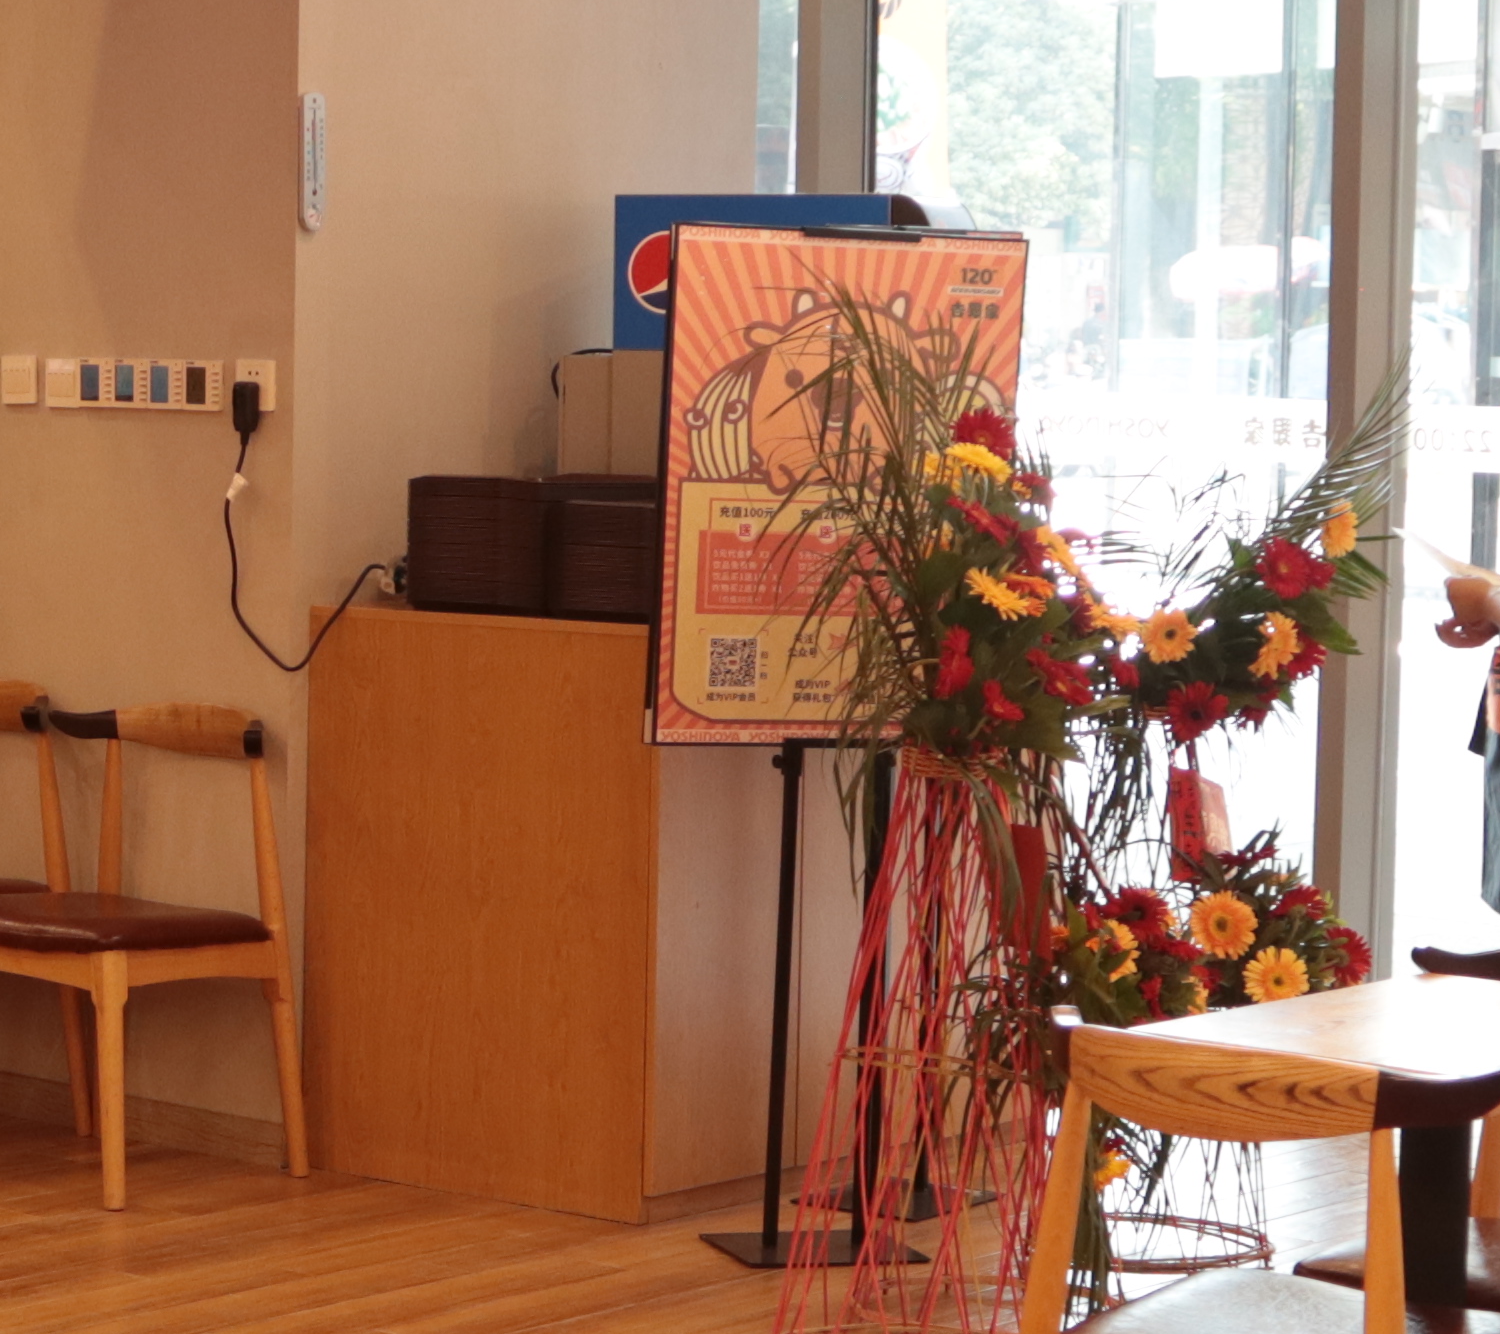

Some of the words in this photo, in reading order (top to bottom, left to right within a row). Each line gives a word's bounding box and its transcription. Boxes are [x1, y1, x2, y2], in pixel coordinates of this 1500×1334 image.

[680, 226, 761, 240] YOSHINOYA
[943, 238, 1024, 253] YOSHINOYA
[961, 268, 993, 285] 120
[661, 730, 741, 742] YOSHINOYA
